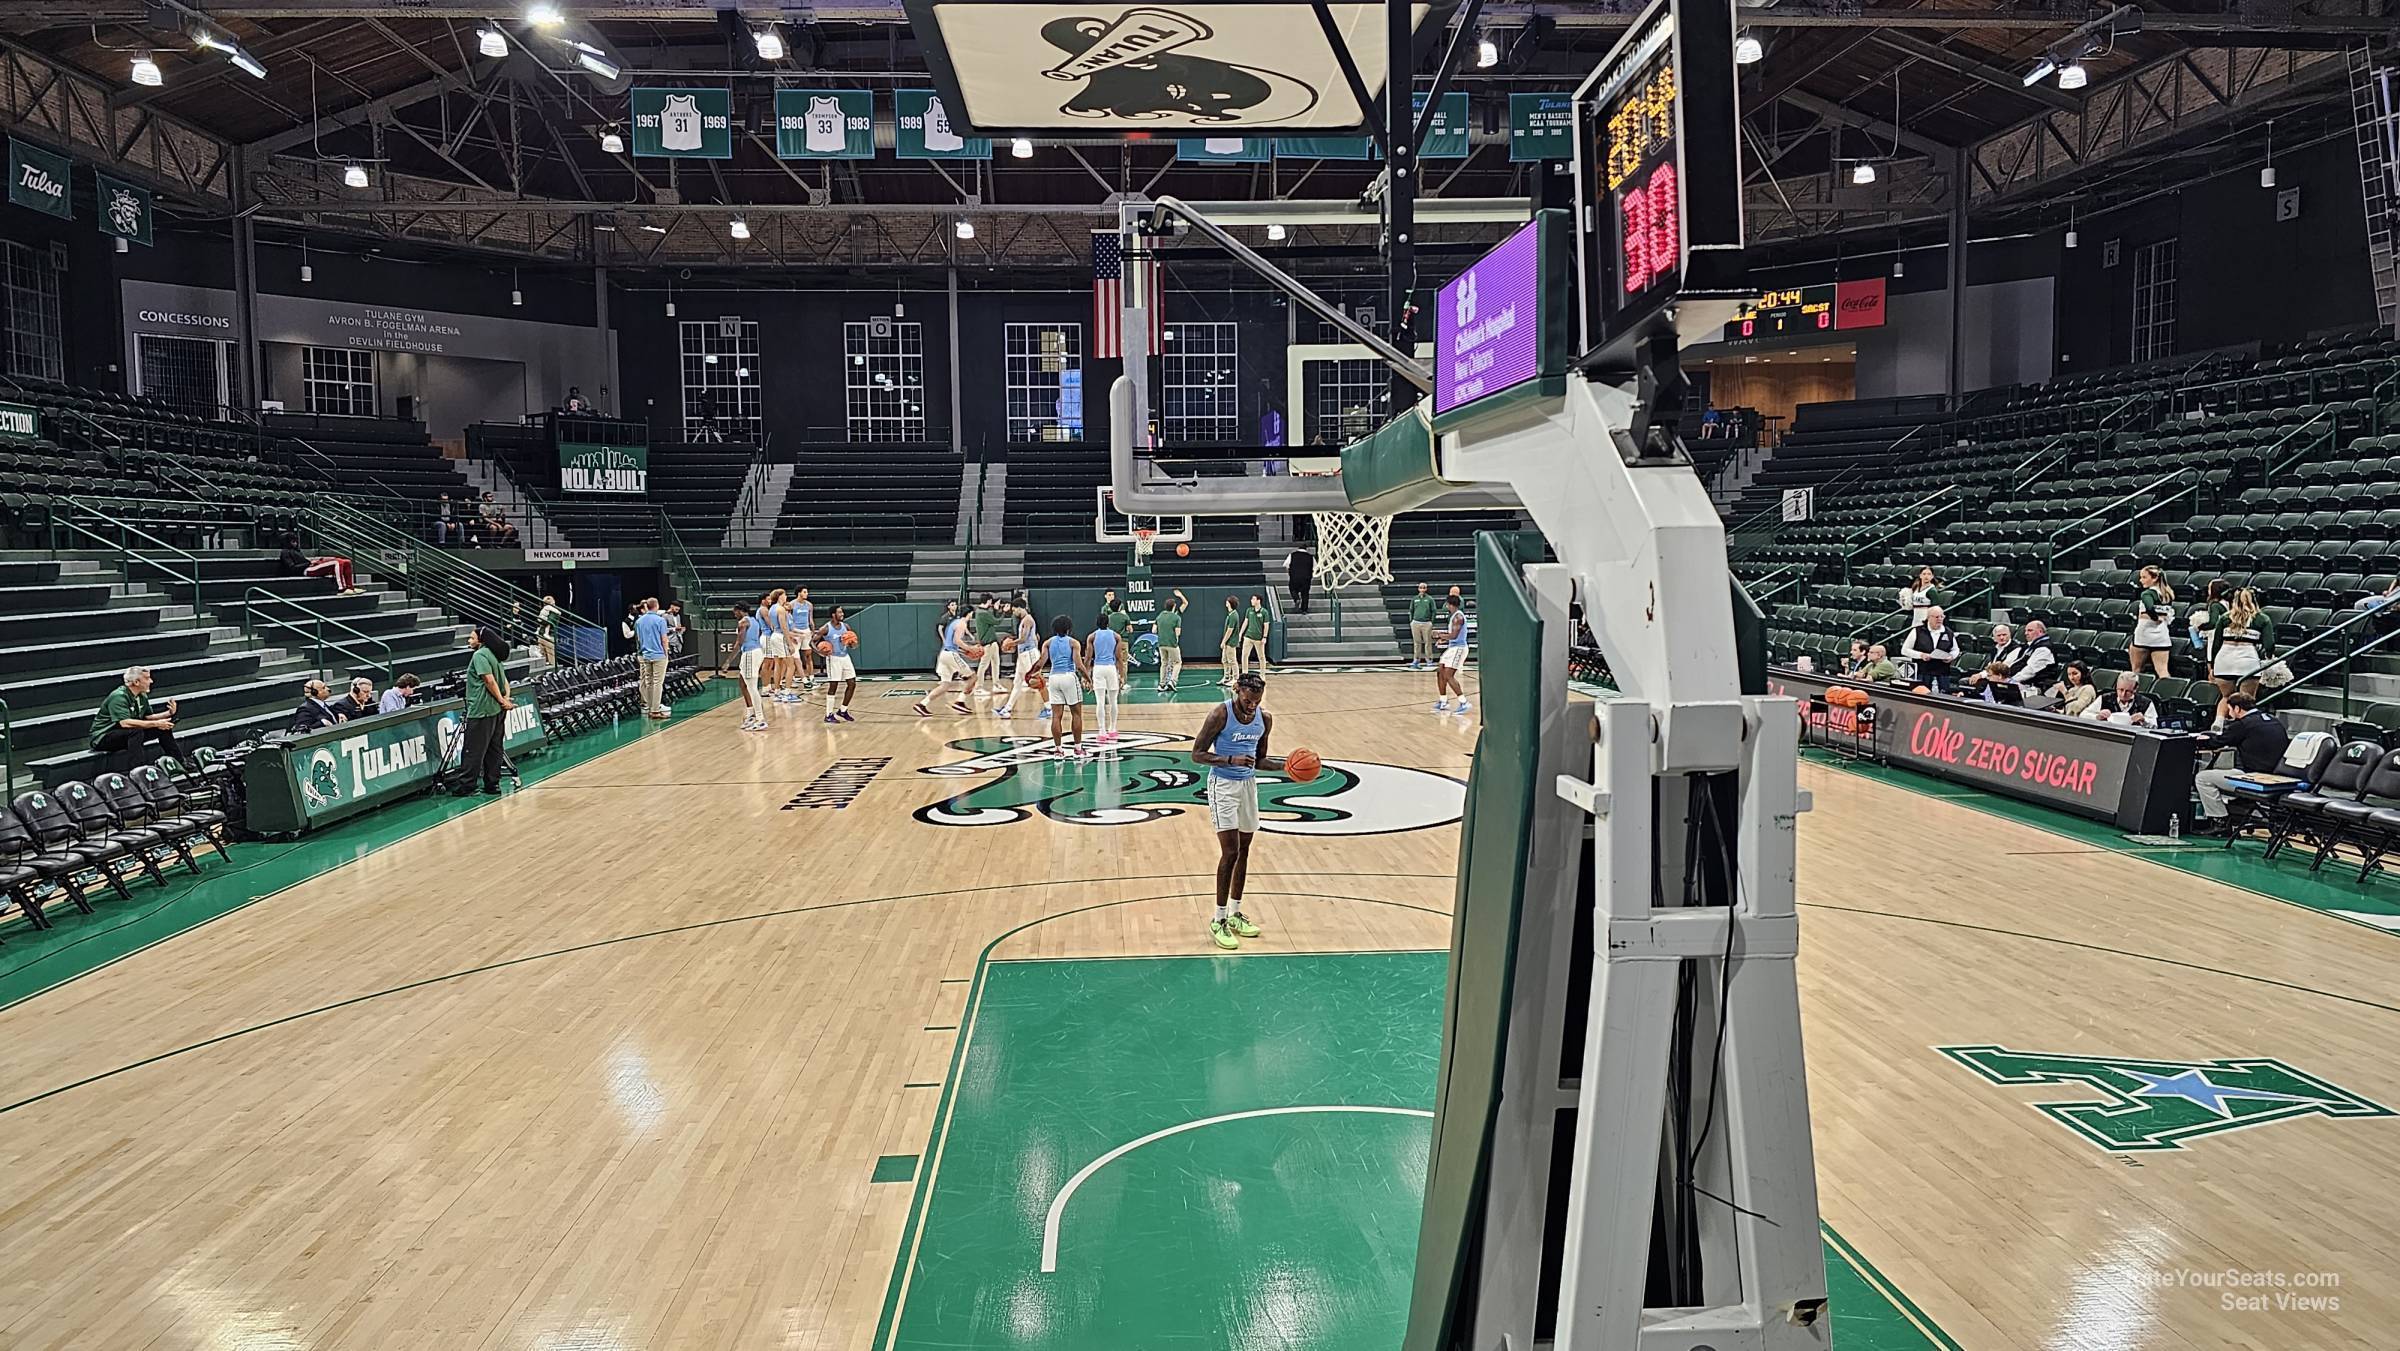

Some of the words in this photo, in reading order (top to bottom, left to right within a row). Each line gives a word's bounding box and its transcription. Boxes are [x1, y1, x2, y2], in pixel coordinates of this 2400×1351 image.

[1077, 24, 1179, 70] TULANE
[636, 114, 660, 128] 1967
[703, 115, 727, 129] 1969
[780, 116, 804, 130] 1980
[900, 116, 923, 130] 1989
[1529, 112, 1546, 120] MEN'S
[675, 118, 688, 133] 31
[818, 120, 832, 134] 33
[847, 117, 870, 130] 1983
[20, 163, 64, 198] Tulsa
[2283, 199, 2292, 217] S
[2107, 251, 2115, 265] R
[1758, 289, 1801, 309] 20:44
[139, 310, 230, 328] CONCESSIONS
[365, 309, 402, 321] TULANE
[404, 313, 425, 323] GYM
[1360, 314, 1371, 328] Q
[1770, 311, 1787, 319] PERIOD
[1817, 311, 1830, 329] 0
[329, 315, 361, 326] AVRON
[364, 318, 374, 328] B.
[376, 320, 427, 332] FOGELMAN
[429, 326, 460, 336] ARENA
[725, 322, 736, 335] N
[875, 323, 887, 335] O
[1741, 320, 1753, 336] 0
[1777, 318, 1783, 330] 1
[394, 331, 409, 340] the
[349, 336, 383, 348] DEVLIN
[386, 340, 443, 352] FIELDHOUSE
[533, 551, 575, 559] NEWCOMB
[1128, 580, 1152, 593] ROLL
[1127, 600, 1156, 613] WAVE
[1910, 711, 1965, 765] Coke
[1966, 737, 2019, 776] ZERO
[2020, 750, 2098, 796] SUGAR
[341, 733, 427, 799] TULANE
